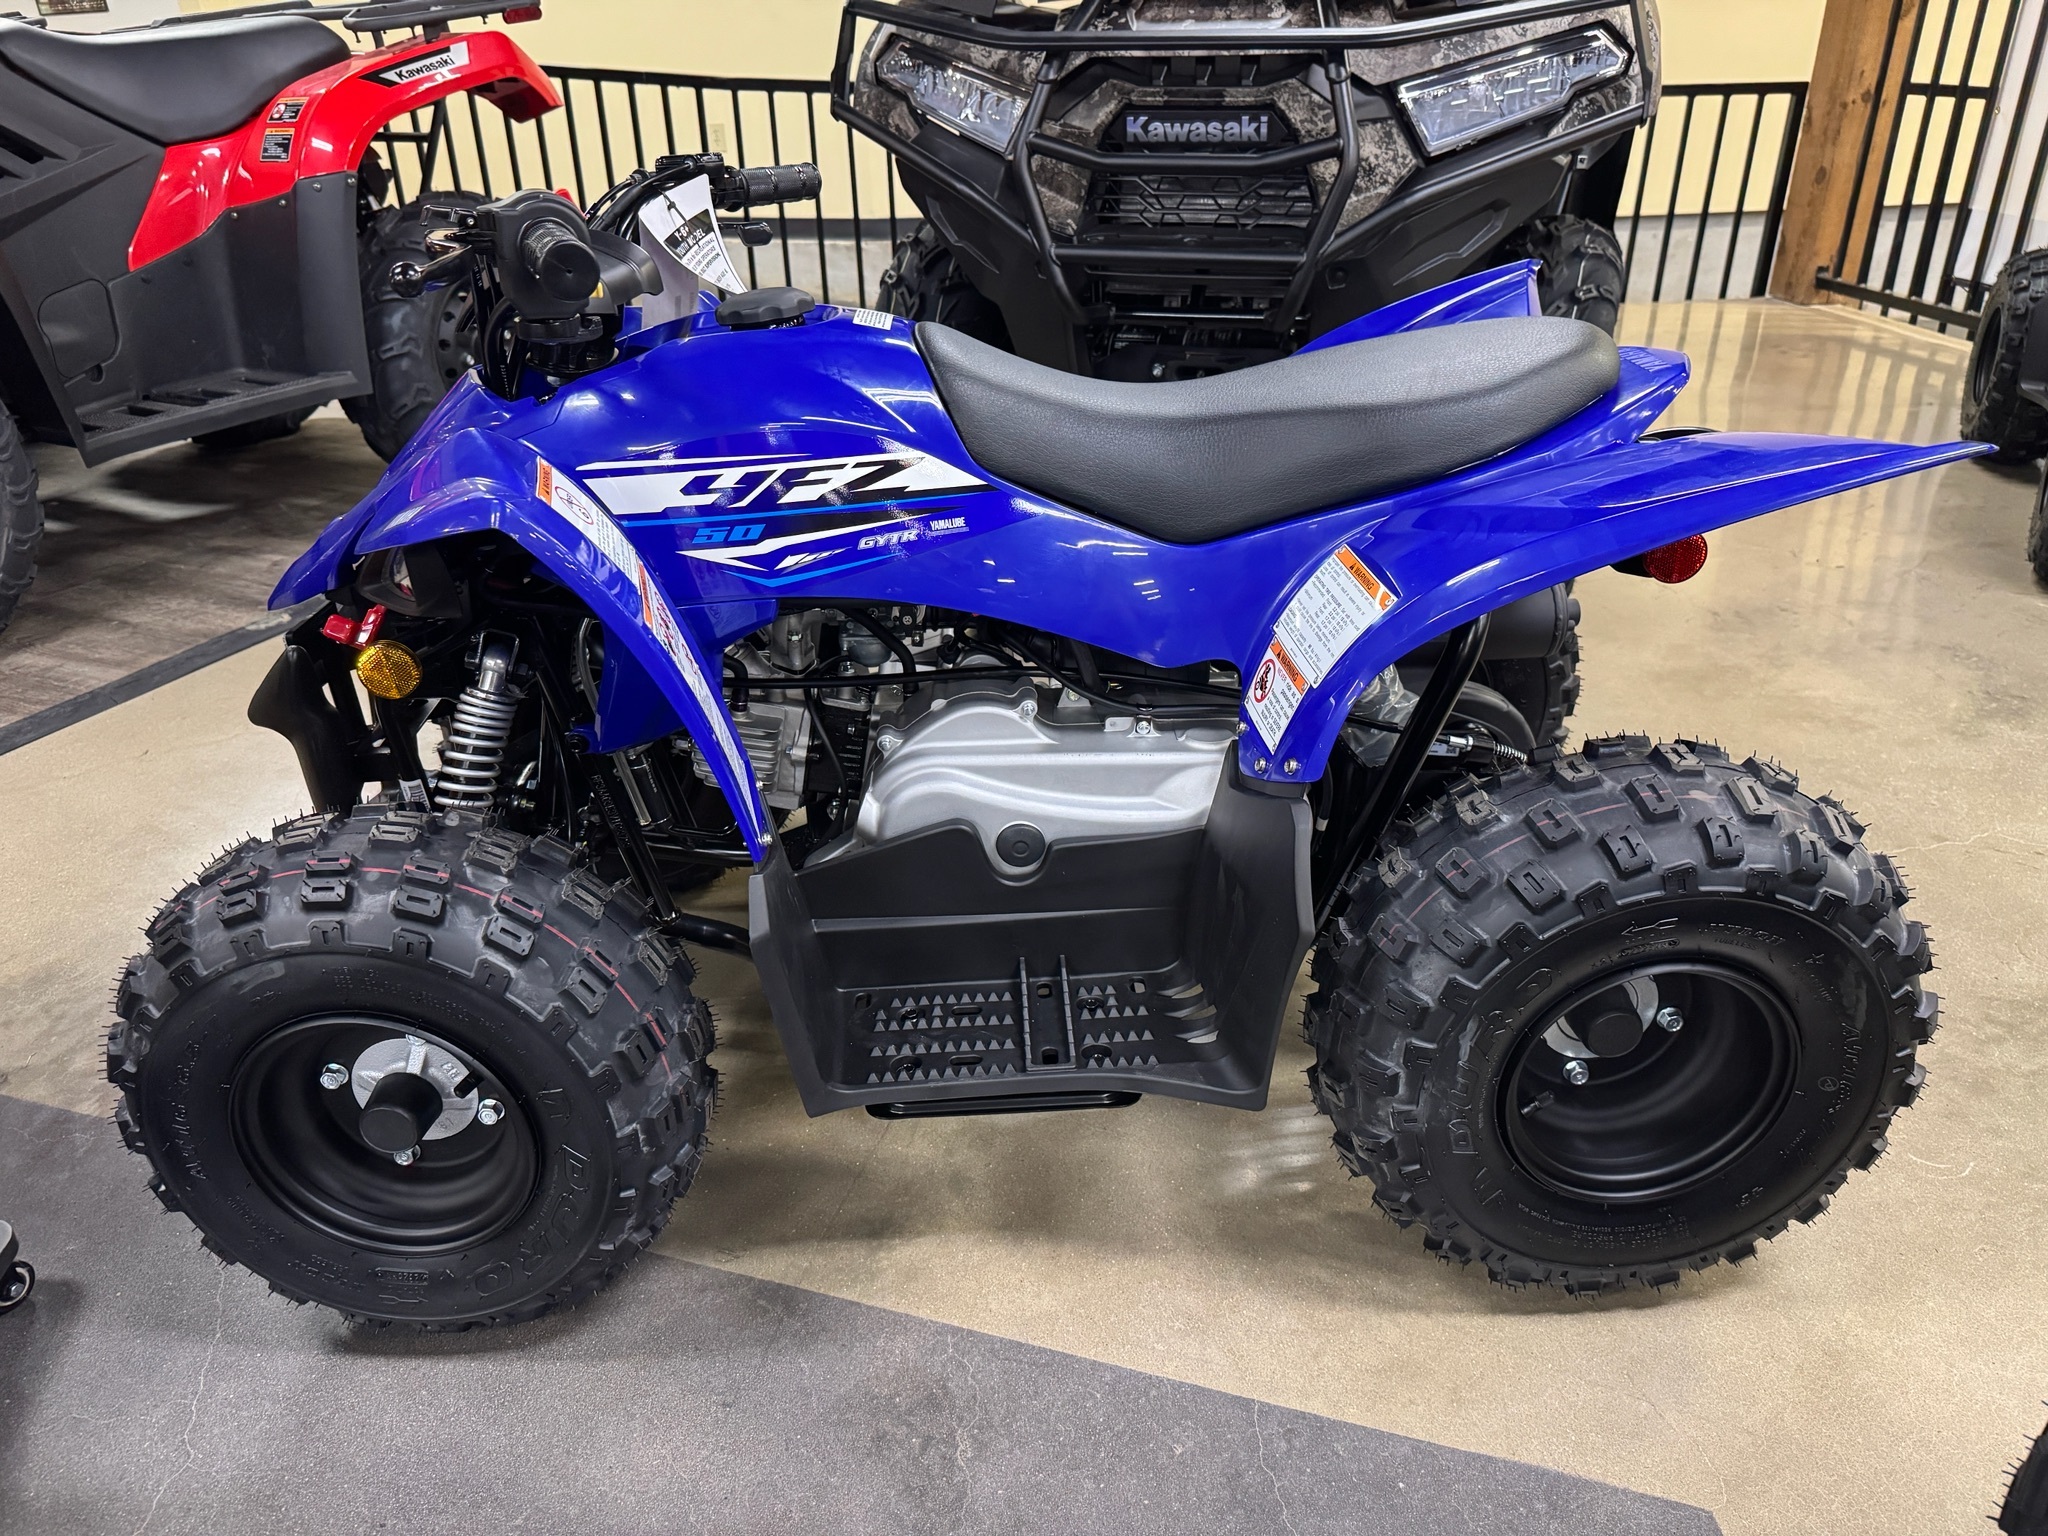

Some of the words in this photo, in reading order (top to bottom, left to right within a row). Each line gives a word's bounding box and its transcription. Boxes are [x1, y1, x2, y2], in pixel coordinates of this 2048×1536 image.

[394, 54, 455, 82] Kawasaki
[1126, 115, 1269, 143] Kawasaki
[686, 228, 706, 247] MODEL
[680, 455, 928, 509] YFZ
[692, 523, 766, 544] 50
[930, 517, 966, 531] YAMALUBE
[857, 530, 919, 550] GYTR
[1352, 566, 1375, 590] WARNING
[1276, 666, 1287, 683] NEVER
[1279, 653, 1299, 682] WARNING
